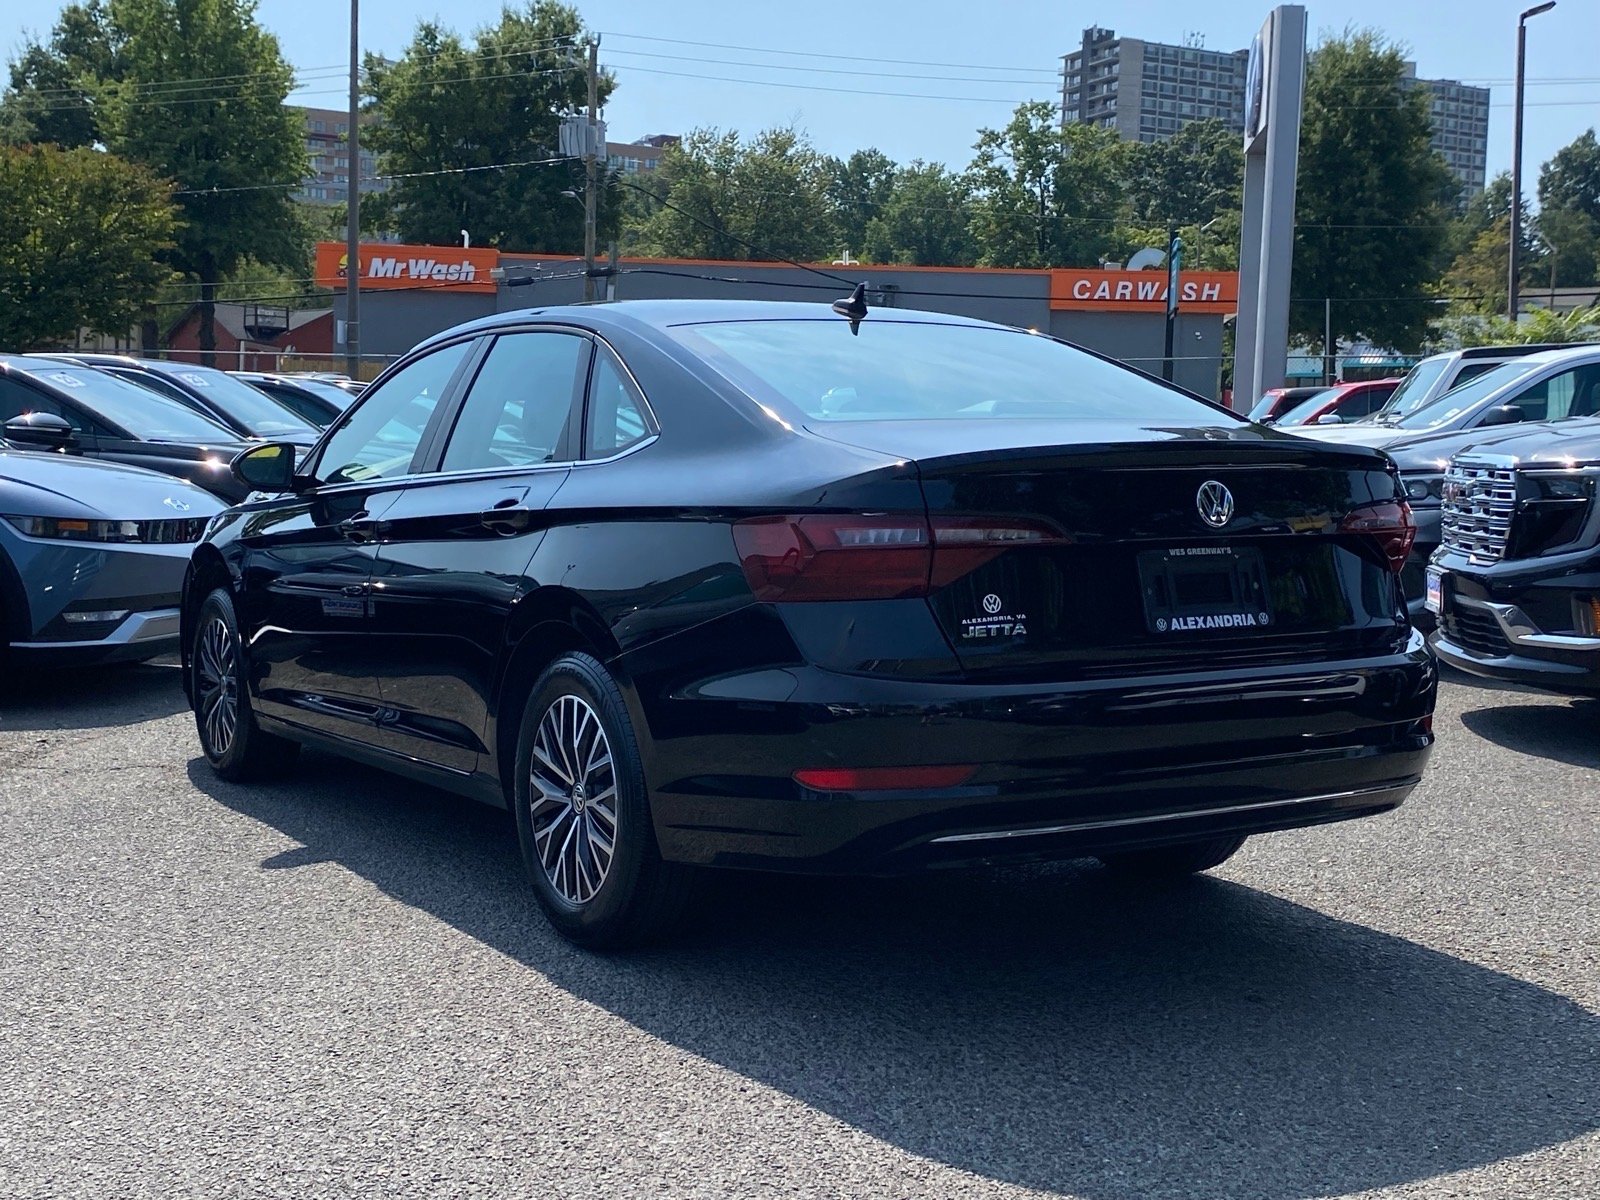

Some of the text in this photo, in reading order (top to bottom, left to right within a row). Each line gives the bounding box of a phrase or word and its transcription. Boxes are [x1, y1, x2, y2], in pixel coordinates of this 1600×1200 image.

[1072, 279, 1221, 301] CARWSH
[1168, 548, 1186, 556] WES
[961, 622, 1027, 639] JETTA
[1171, 613, 1257, 631] ALEXANDRIA
